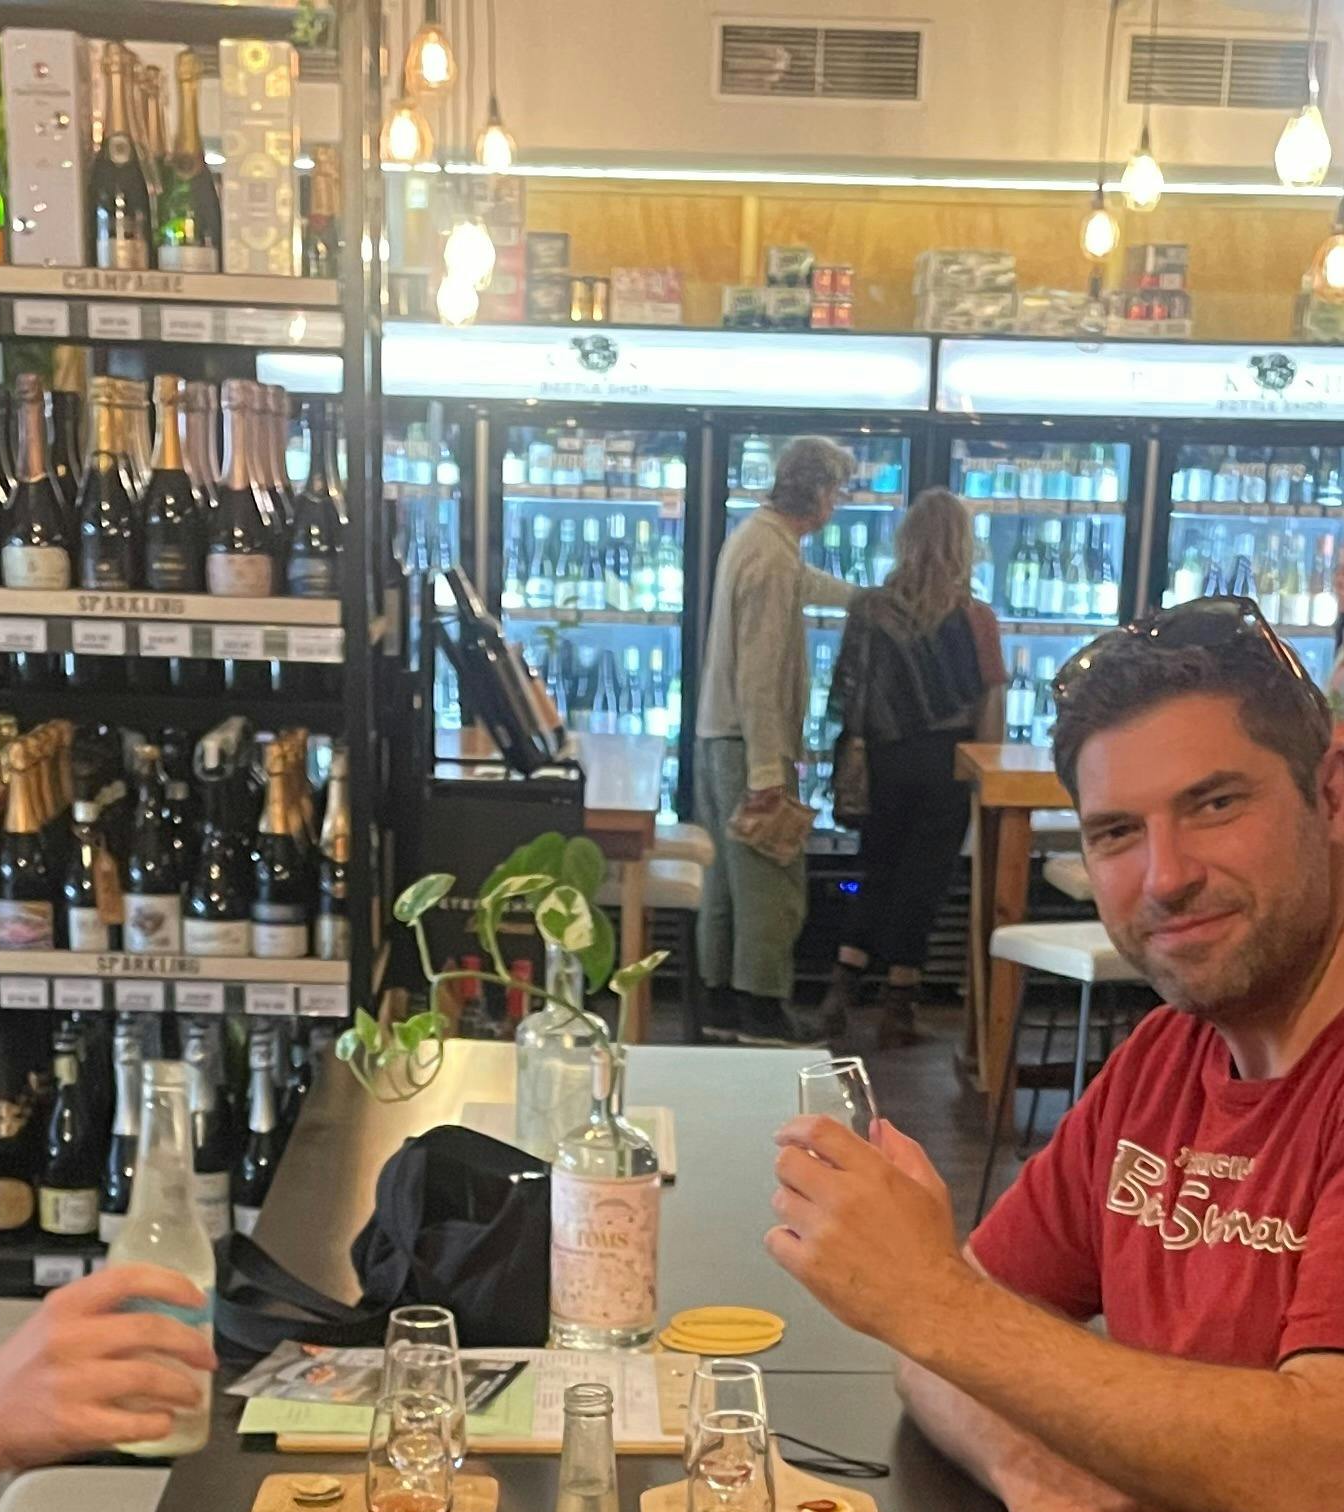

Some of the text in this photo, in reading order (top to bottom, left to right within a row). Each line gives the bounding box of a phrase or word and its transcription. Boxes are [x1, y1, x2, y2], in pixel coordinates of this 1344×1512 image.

[61, 270, 185, 293] CHAMPAGNE
[76, 595, 186, 615] SPARKLING
[96, 955, 202, 976] SPARKLING
